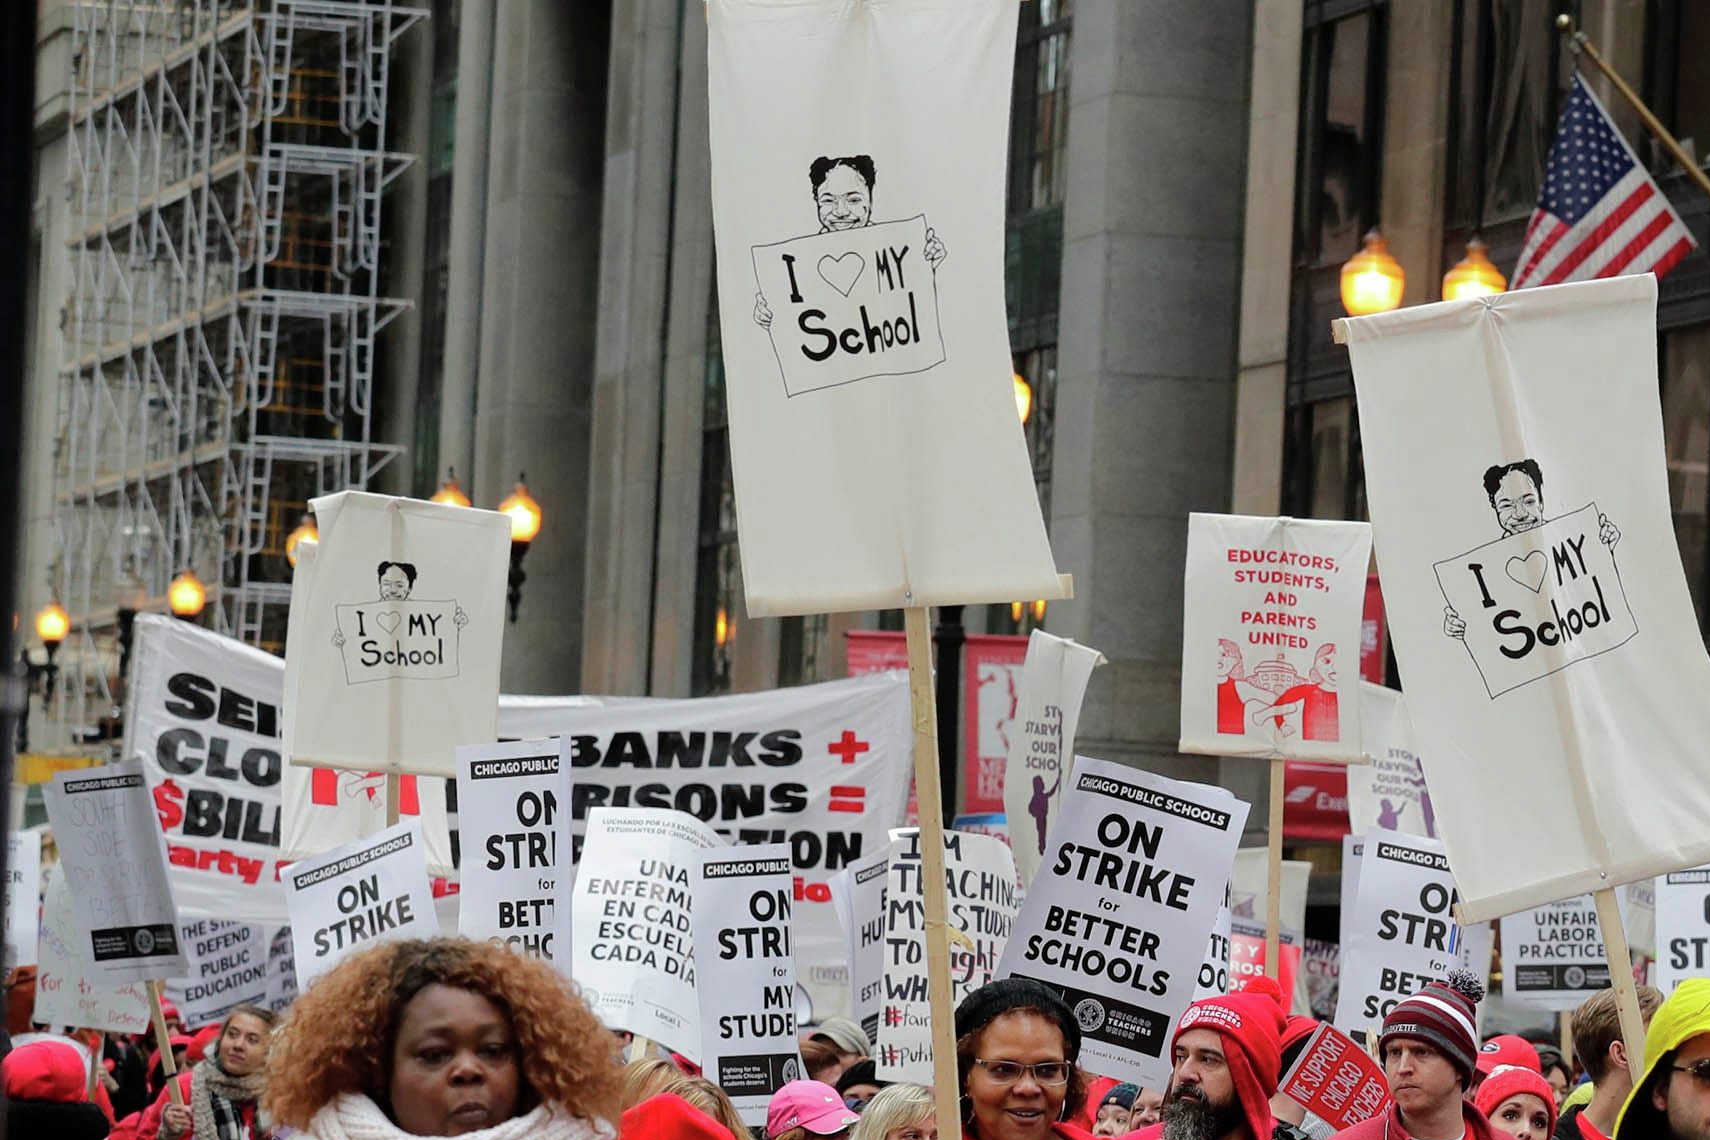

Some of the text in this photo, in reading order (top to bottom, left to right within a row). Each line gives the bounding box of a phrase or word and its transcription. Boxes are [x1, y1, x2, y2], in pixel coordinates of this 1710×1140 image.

[782, 245, 909, 303] I MY
[798, 292, 920, 362] School
[1227, 548, 1340, 573] EDUCATORS,
[1468, 534, 1587, 608] I MY
[1234, 570, 1330, 593] STUDENTS,
[1263, 592, 1298, 607] AND
[356, 610, 442, 636] I MY
[1241, 611, 1317, 630] PARENTS
[1493, 575, 1611, 659] School
[361, 638, 443, 666] School
[1248, 632, 1309, 649] UNITED
[571, 730, 803, 768] BANKS
[474, 758, 558, 776] CHICAGO PUBLIC
[1080, 776, 1227, 827] CHICAGO PUBLIC SCHOOLS
[1096, 813, 1164, 860] ON
[297, 836, 410, 888] CHICAGO PUBLIC SCHOOLS
[1381, 845, 1433, 866] CHICAGO
[640, 859, 688, 887] UNA
[706, 862, 754, 877] CHICAGO
[1052, 841, 1196, 911] STRIKE
[337, 874, 380, 914] ON
[538, 877, 555, 890] for
[604, 899, 635, 918] EN
[1098, 897, 1120, 913] for
[314, 894, 414, 957] STRIKE
[1535, 911, 1597, 926] UNFAIR
[196, 927, 250, 957] DEFEND
[1044, 905, 1161, 961] BETTER
[1538, 928, 1597, 942] LABOR
[200, 951, 250, 977] PUBLIC
[591, 943, 657, 969] CADA
[887, 938, 921, 965] TO
[1429, 958, 1447, 971] for
[773, 966, 787, 977] for
[1024, 934, 1170, 996] SCHOOLS
[185, 963, 266, 1002] EDUCATION!
[764, 985, 793, 1009] MY
[1107, 1017, 1152, 1037] TEACHERS
[1288, 1032, 1346, 1103] WE SUPPORT
[1320, 1061, 1364, 1111] CHICAGO
